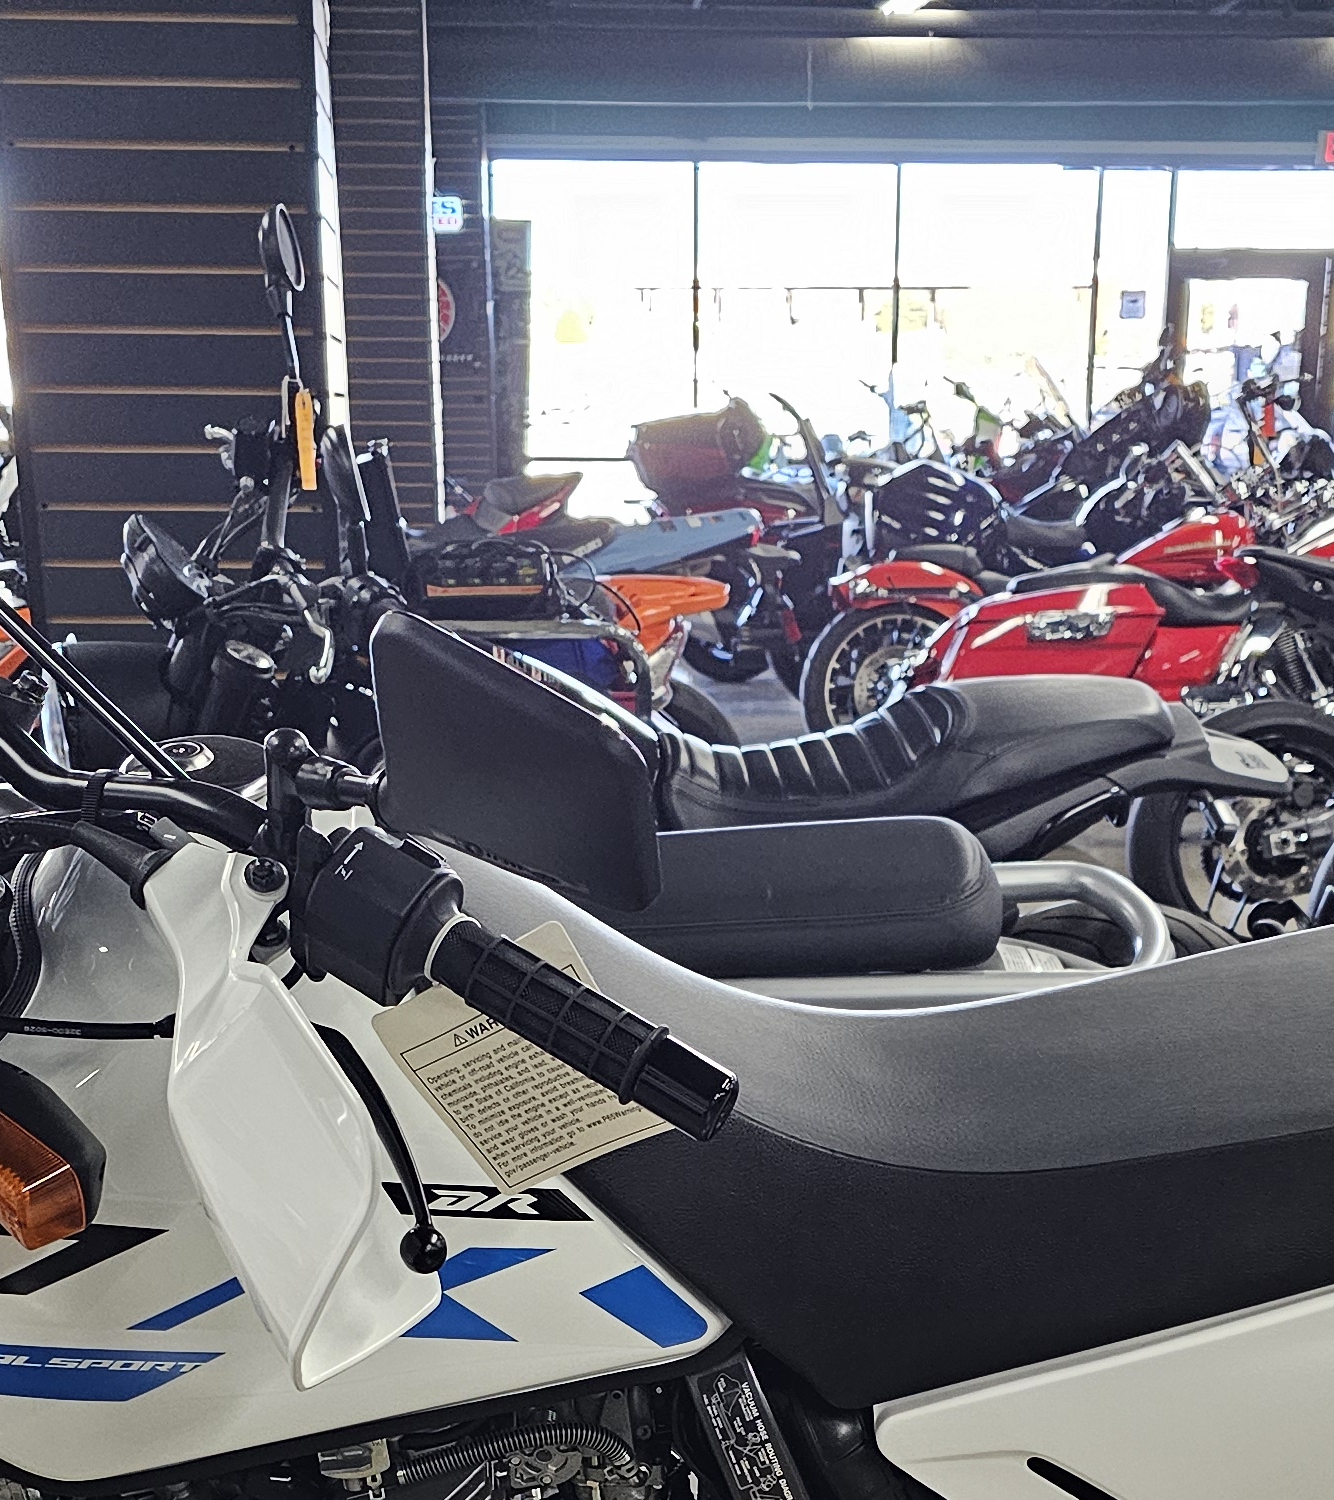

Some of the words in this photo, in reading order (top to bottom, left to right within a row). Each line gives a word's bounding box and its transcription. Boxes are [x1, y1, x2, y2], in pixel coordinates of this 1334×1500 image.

[465, 1019, 499, 1039] WAR
[427, 1067, 462, 1084] Operating,
[462, 1052, 492, 1069] servicing
[492, 1044, 506, 1055] and
[434, 1079, 457, 1092] vehicle
[468, 1061, 495, 1077] off-road
[496, 1050, 519, 1064] vehicle
[521, 1044, 534, 1053] can
[441, 1083, 473, 1100] chemicals
[473, 1069, 504, 1085] including
[504, 1058, 527, 1072] engine
[447, 1091, 481, 1108] monoxide,
[480, 1075, 517, 1093] phthalates,
[517, 1066, 531, 1076] and
[530, 1059, 549, 1070] lead,
[459, 1113, 477, 1123] birth
[477, 1101, 501, 1115] defects
[512, 1088, 529, 1099] other
[531, 1071, 571, 1091] reproductive
[462, 1103, 474, 1111] the
[475, 1094, 494, 1105] State
[503, 1076, 536, 1092] California
[546, 1063, 566, 1074] cause
[478, 1110, 506, 1126] minimize
[507, 1096, 540, 1112] exposure,
[540, 1085, 559, 1097] avoid
[479, 1132, 503, 1146] service
[504, 1124, 519, 1136] your
[521, 1113, 544, 1126] vehicle
[484, 1124, 495, 1133] not
[497, 1119, 509, 1127] idle
[524, 1102, 546, 1114] engine
[548, 1091, 570, 1104] except
[486, 1143, 499, 1154] and
[500, 1136, 516, 1146] wear
[518, 1126, 539, 1140] gloves
[550, 1113, 568, 1123] wash
[569, 1105, 584, 1117] your
[585, 1098, 607, 1108] hands
[492, 1150, 510, 1161] when
[511, 1136, 541, 1152] servicing
[541, 1128, 556, 1140] your
[558, 1118, 583, 1130] vehicle.
[497, 1160, 509, 1169] For
[511, 1152, 528, 1162] more
[528, 1135, 565, 1154] information
[566, 1130, 576, 1139] go
[504, 1141, 577, 1178] gov/passenger-vehicle.
[427, 1189, 540, 1215] DR
[742, 1382, 759, 1417] VACUUM
[755, 1419, 769, 1441] HOSE
[765, 1442, 783, 1476] ROUTING
